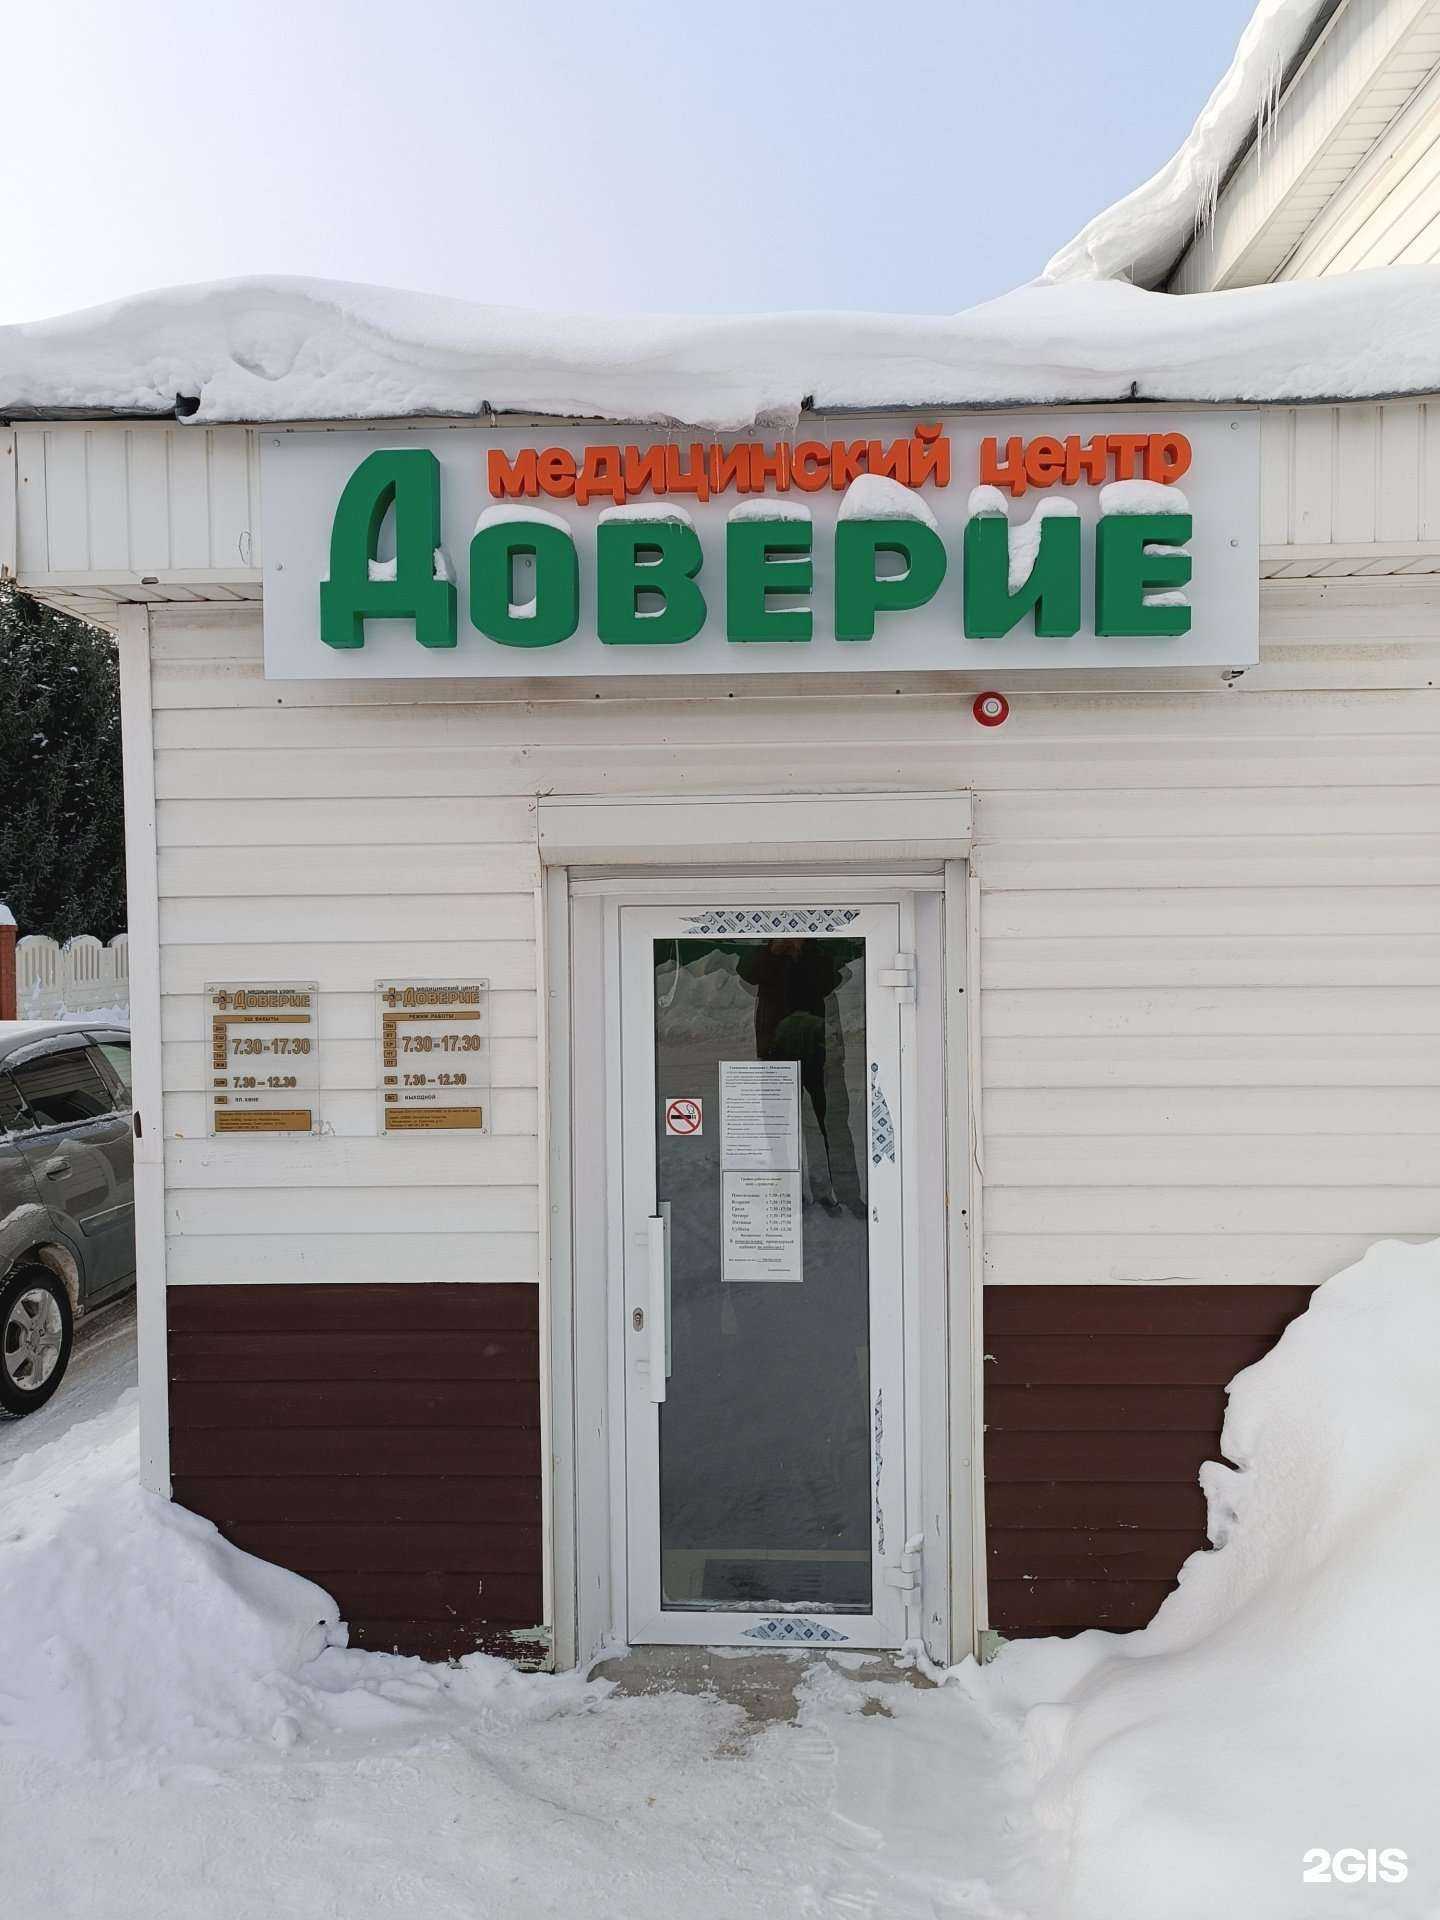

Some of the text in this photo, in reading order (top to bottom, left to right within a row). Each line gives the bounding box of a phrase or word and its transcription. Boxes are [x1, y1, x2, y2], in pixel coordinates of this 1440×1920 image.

[486, 424, 1192, 505] медицинский центр
[319, 449, 1193, 649] ДОВЕРИЕ
[233, 990, 310, 1010] ДОВЕРИЕ
[403, 987, 480, 1008] ДОВЕРИЕ
